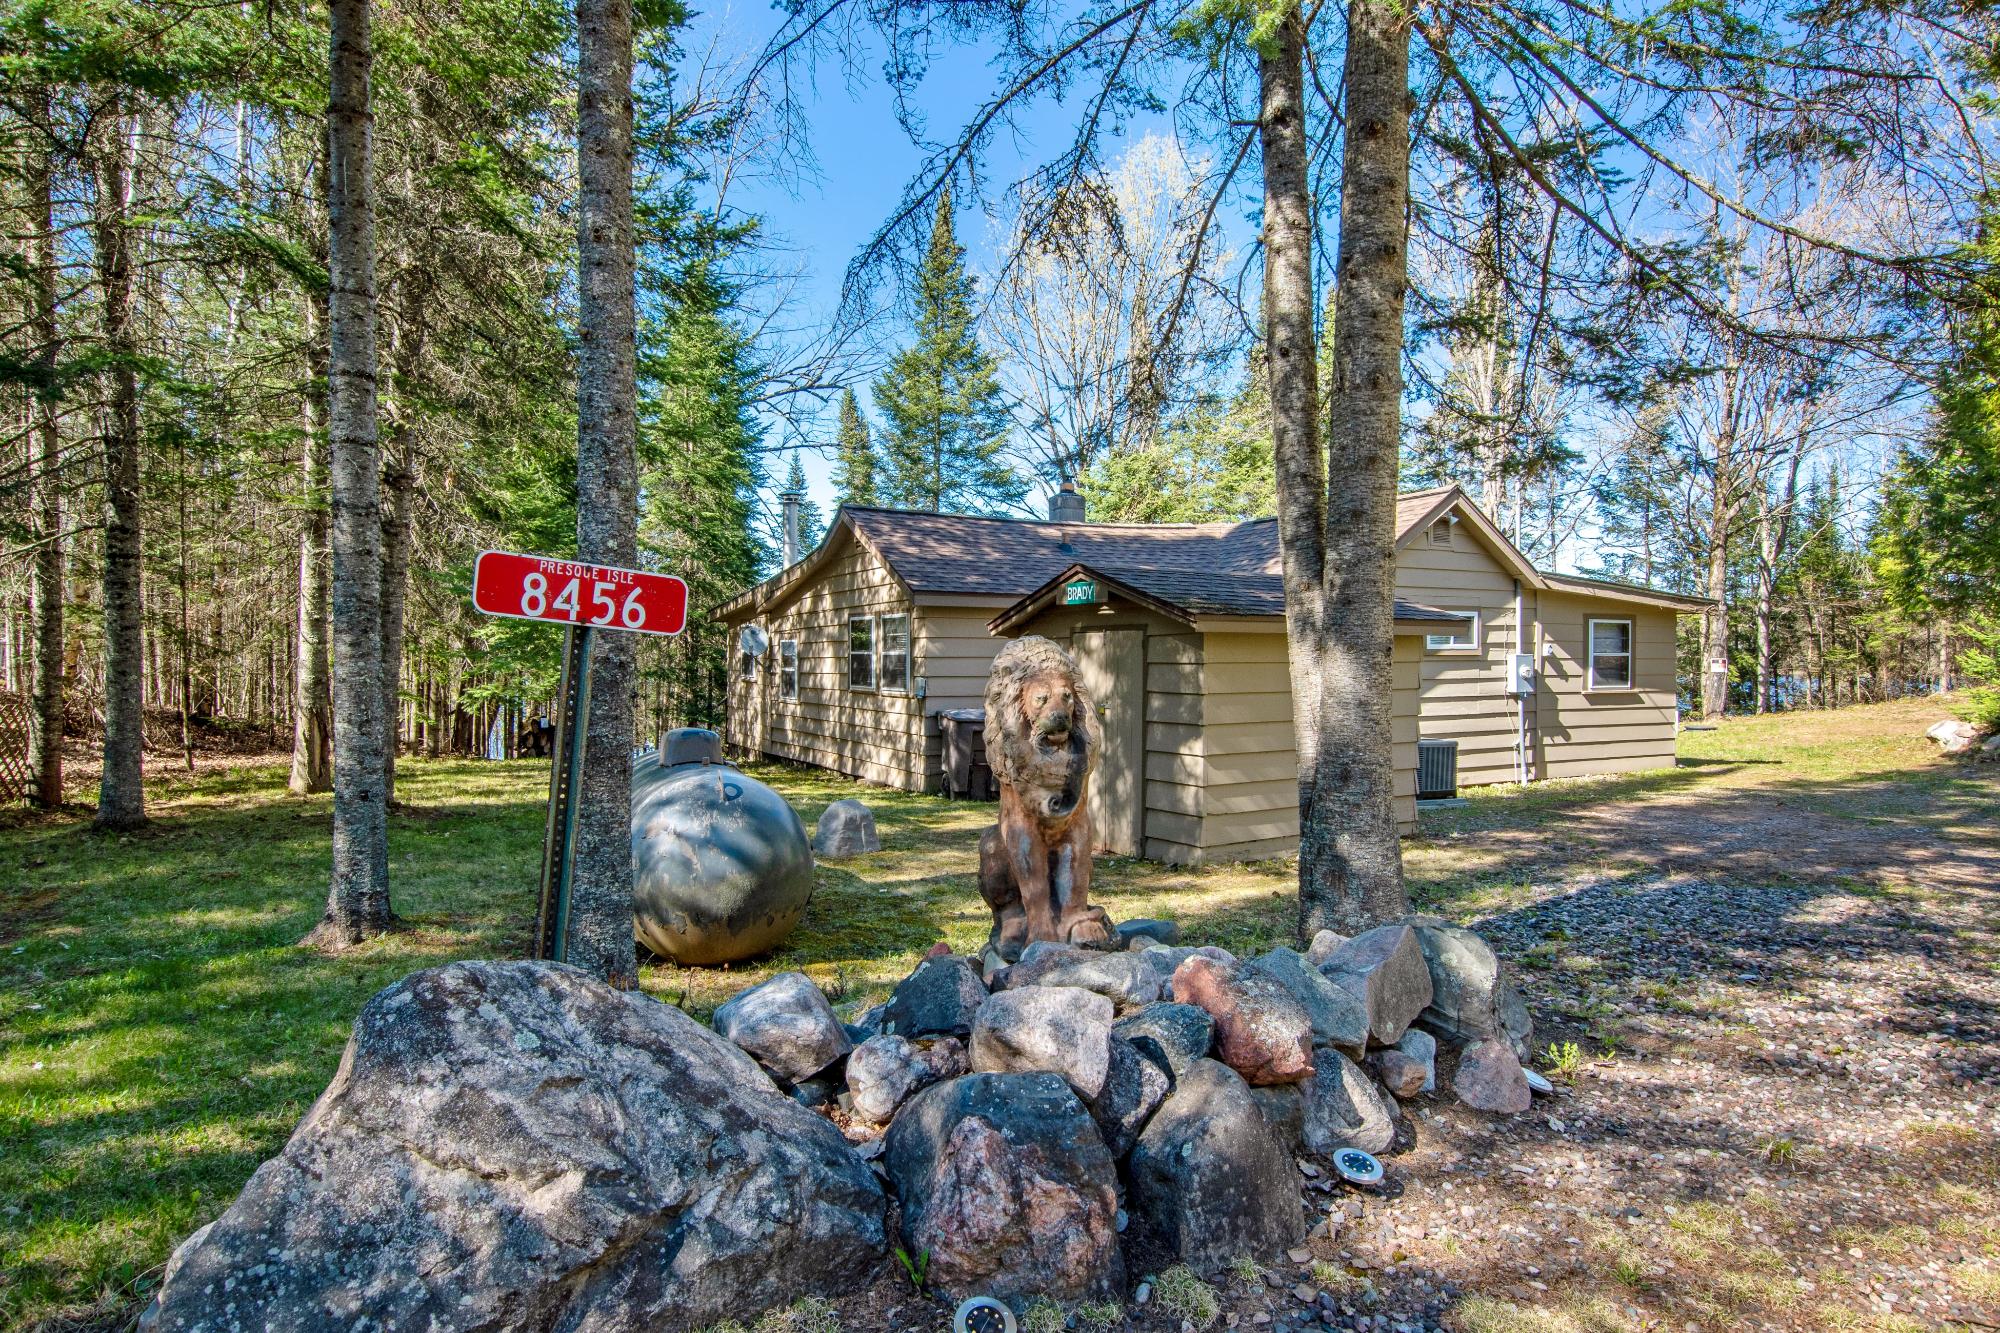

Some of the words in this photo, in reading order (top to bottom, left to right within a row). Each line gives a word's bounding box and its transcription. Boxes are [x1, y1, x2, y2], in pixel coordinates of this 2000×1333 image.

[607, 570, 635, 585] ISLE
[521, 572, 646, 629] 8456
[1067, 585, 1094, 601] BRADY
